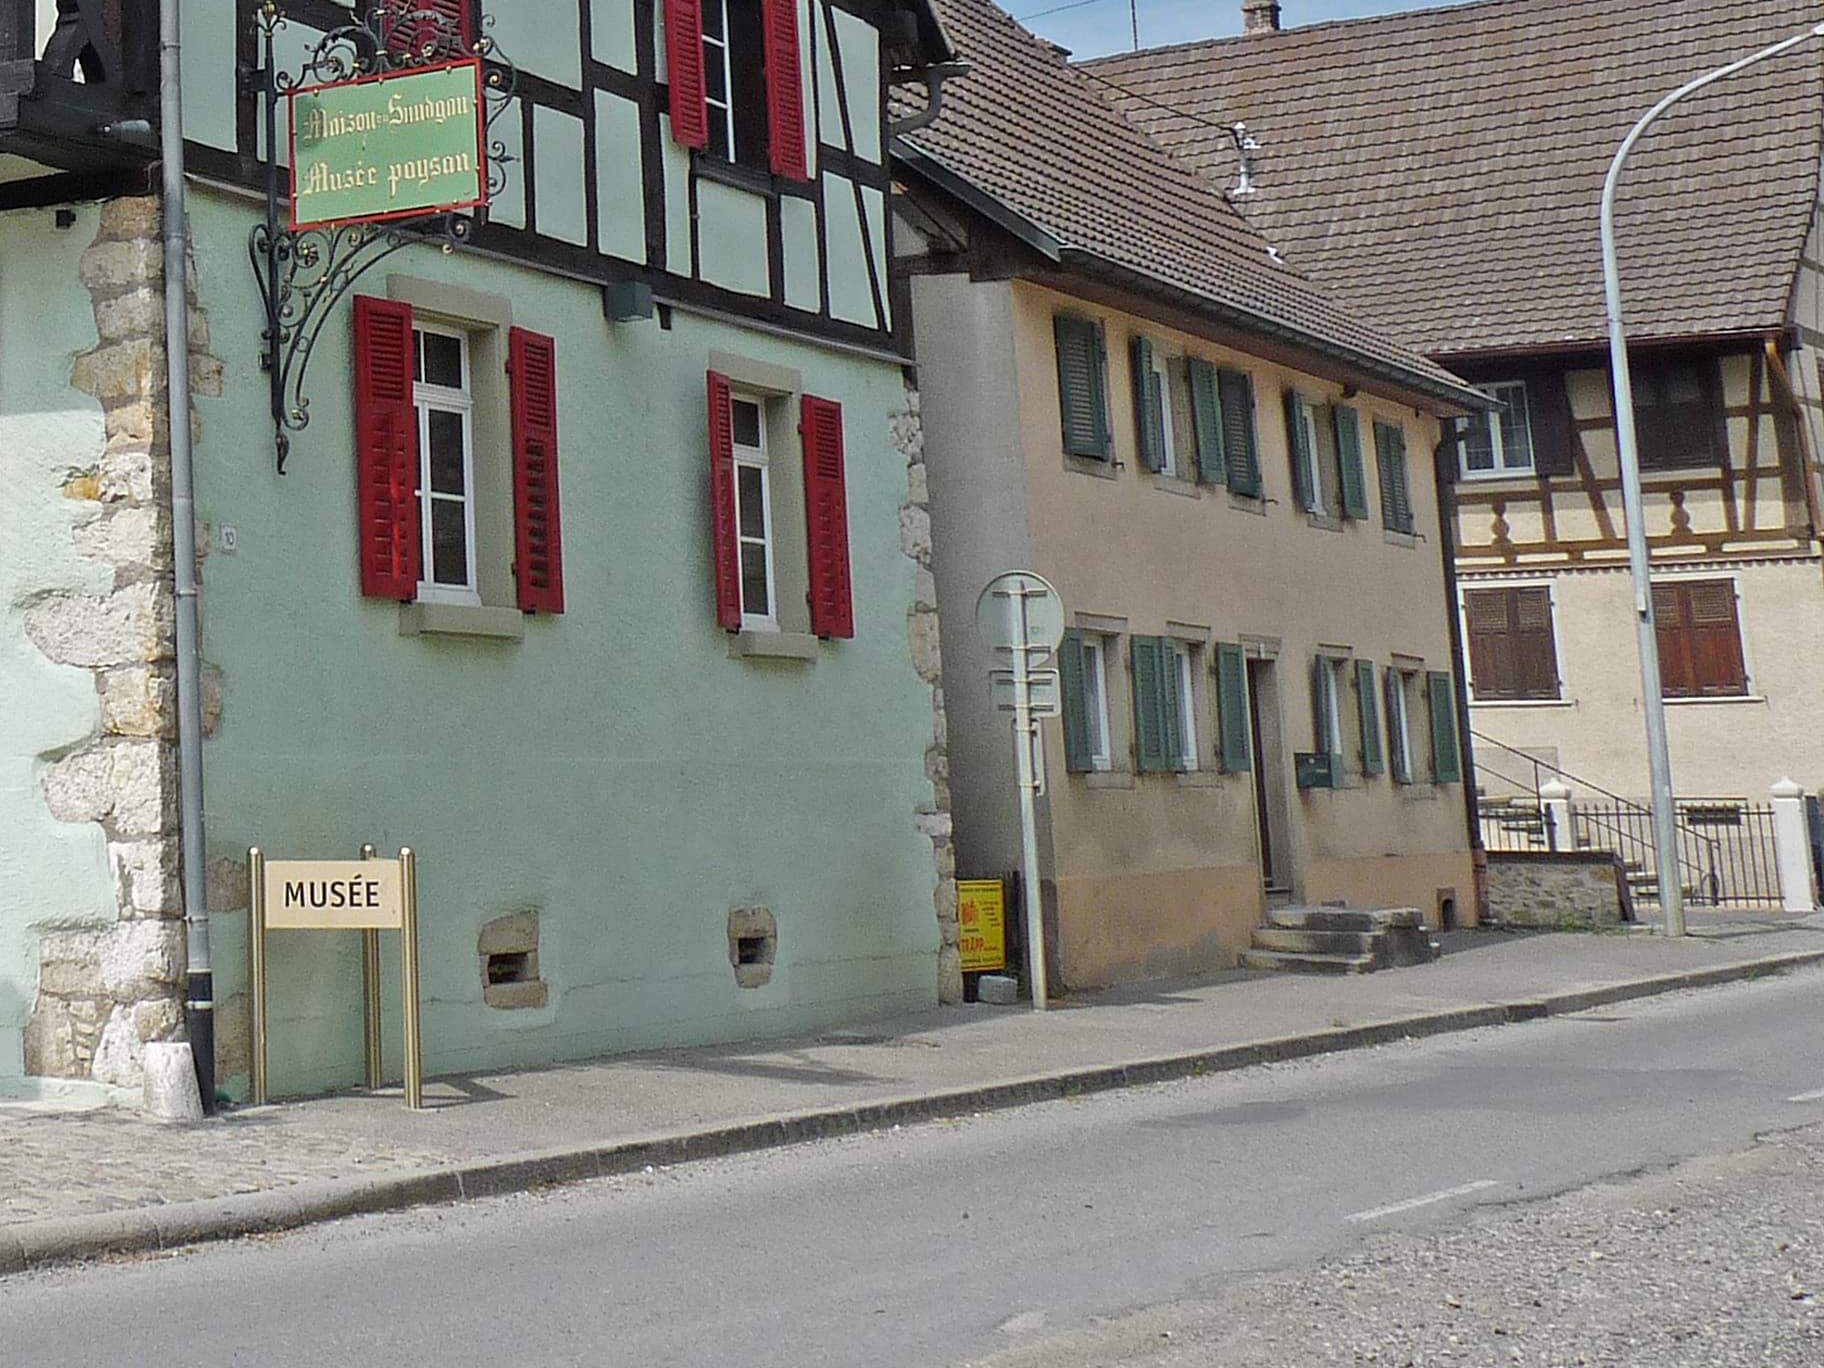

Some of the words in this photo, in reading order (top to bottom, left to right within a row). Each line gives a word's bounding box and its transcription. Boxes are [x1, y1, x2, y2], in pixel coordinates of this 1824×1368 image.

[303, 108, 377, 141] Maison
[387, 94, 470, 129] Sundgau
[303, 160, 378, 196] Musée
[387, 152, 470, 199] paysan
[284, 873, 380, 908] MUSÉE
